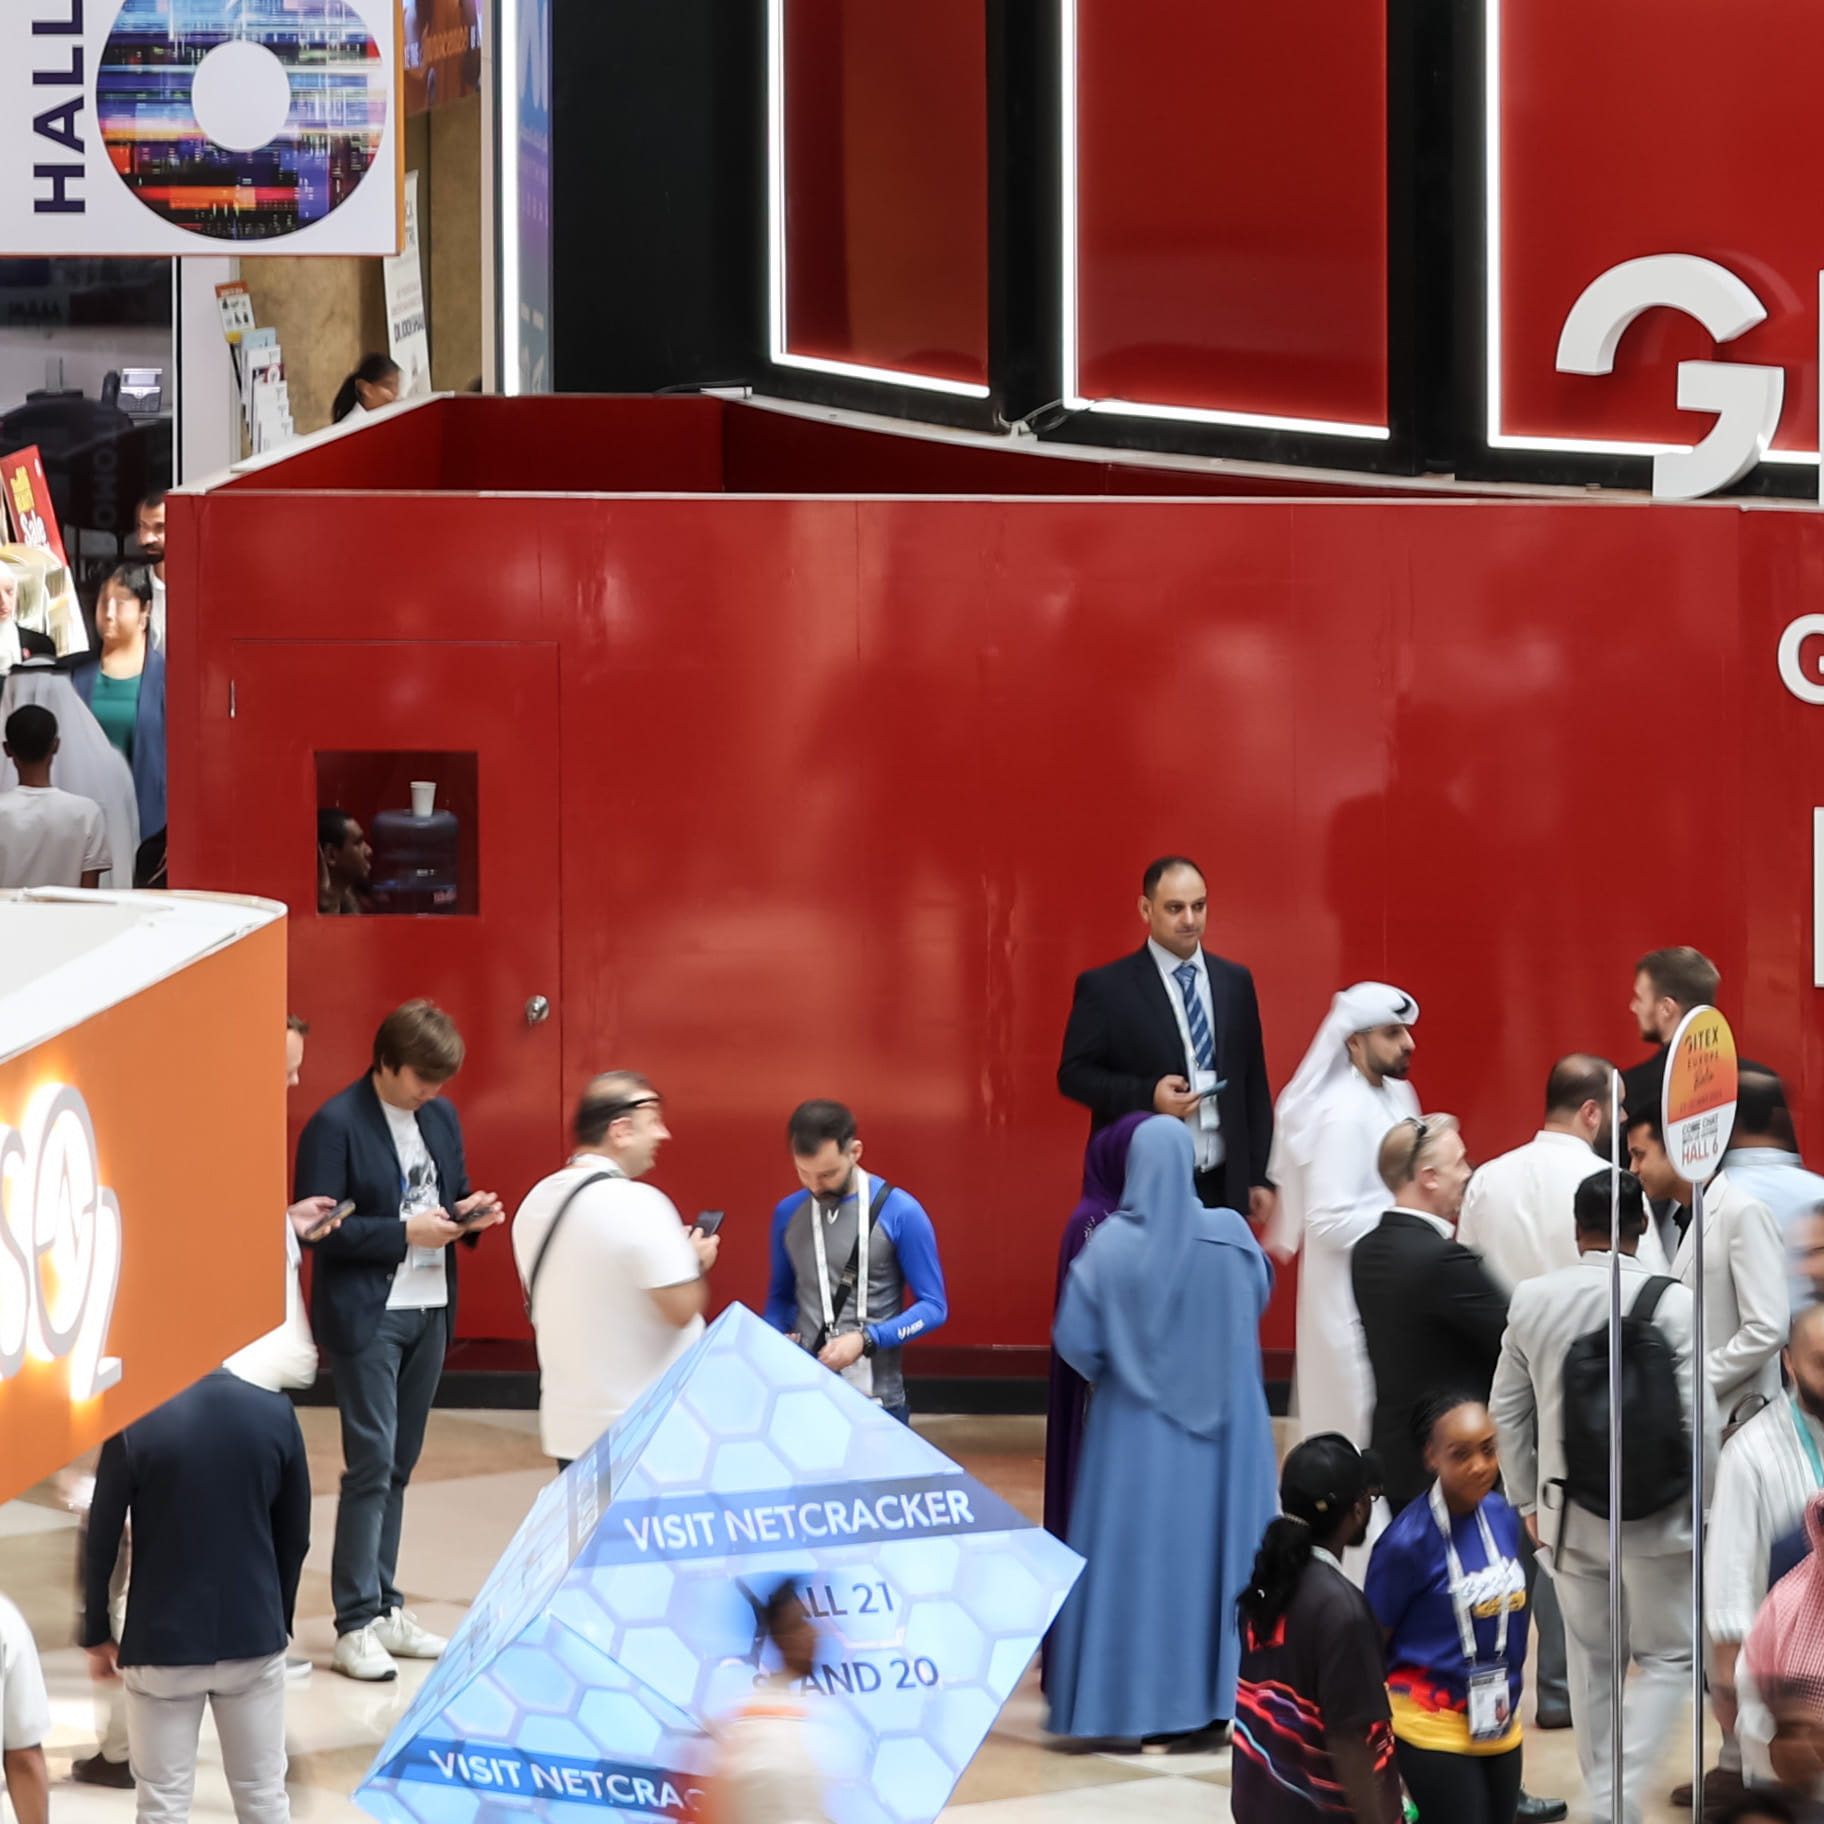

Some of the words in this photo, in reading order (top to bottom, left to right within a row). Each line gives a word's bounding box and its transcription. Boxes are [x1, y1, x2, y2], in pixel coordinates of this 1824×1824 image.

[1684, 1025, 1720, 1055] GITEX
[1681, 1142, 1710, 1167] HALL
[624, 1506, 716, 1553] VISIT
[724, 1488, 976, 1542] NETCRACKER
[852, 1580, 895, 1616] 21
[890, 1656, 939, 1690] 20
[428, 1748, 521, 1788] VISIT
